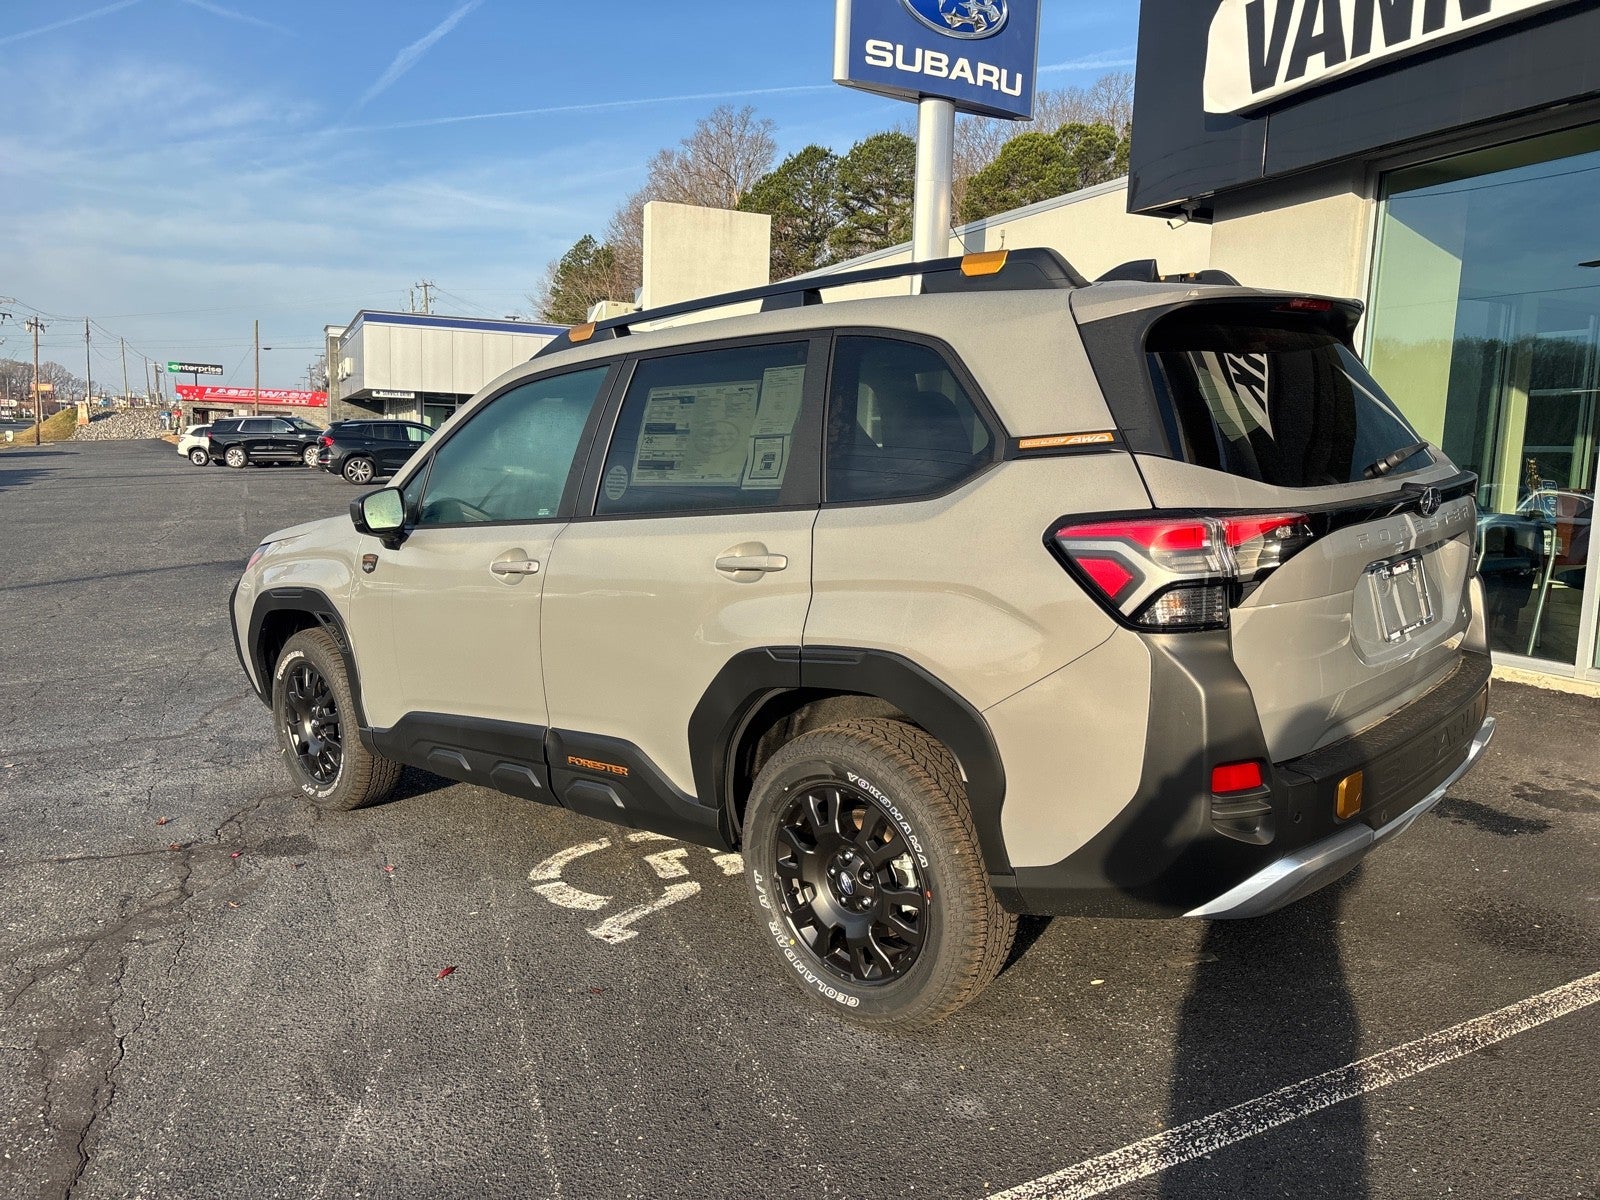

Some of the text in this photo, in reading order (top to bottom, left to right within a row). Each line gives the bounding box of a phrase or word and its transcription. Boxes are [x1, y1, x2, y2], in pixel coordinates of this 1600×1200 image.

[864, 39, 1022, 97] SUBARU
[170, 364, 222, 373] enterprise
[1356, 506, 1470, 549] FORESTER
[567, 755, 628, 776] FORESTER
[846, 771, 929, 869] YOKOHAMA
[754, 869, 860, 1008] GEOLANDAR A/T
